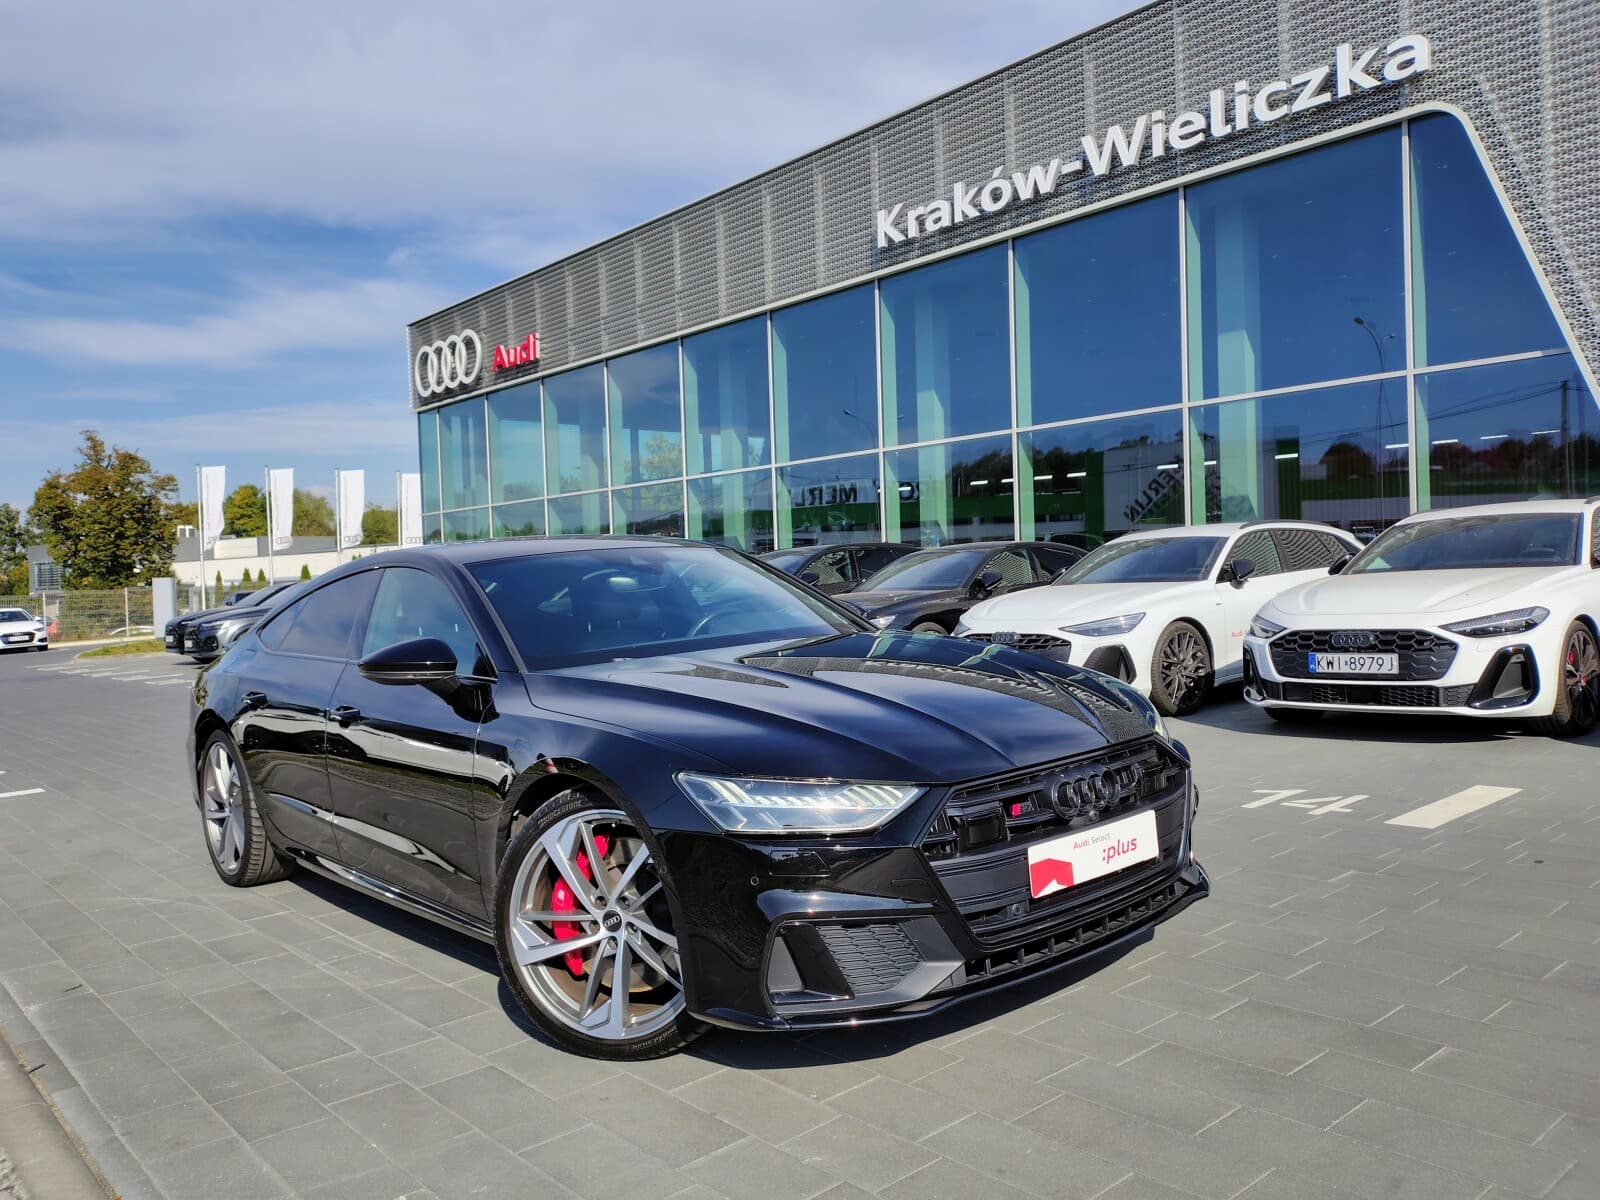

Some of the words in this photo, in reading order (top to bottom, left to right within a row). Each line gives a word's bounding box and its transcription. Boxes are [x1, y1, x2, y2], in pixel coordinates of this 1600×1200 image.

[876, 33, 1432, 250] Kraków-Wieliczka
[492, 332, 541, 372] Audi
[1317, 655, 1341, 671] KWI
[1349, 656, 1393, 671] 8979J
[1073, 839, 1090, 850] Audi
[1090, 832, 1111, 845] Select
